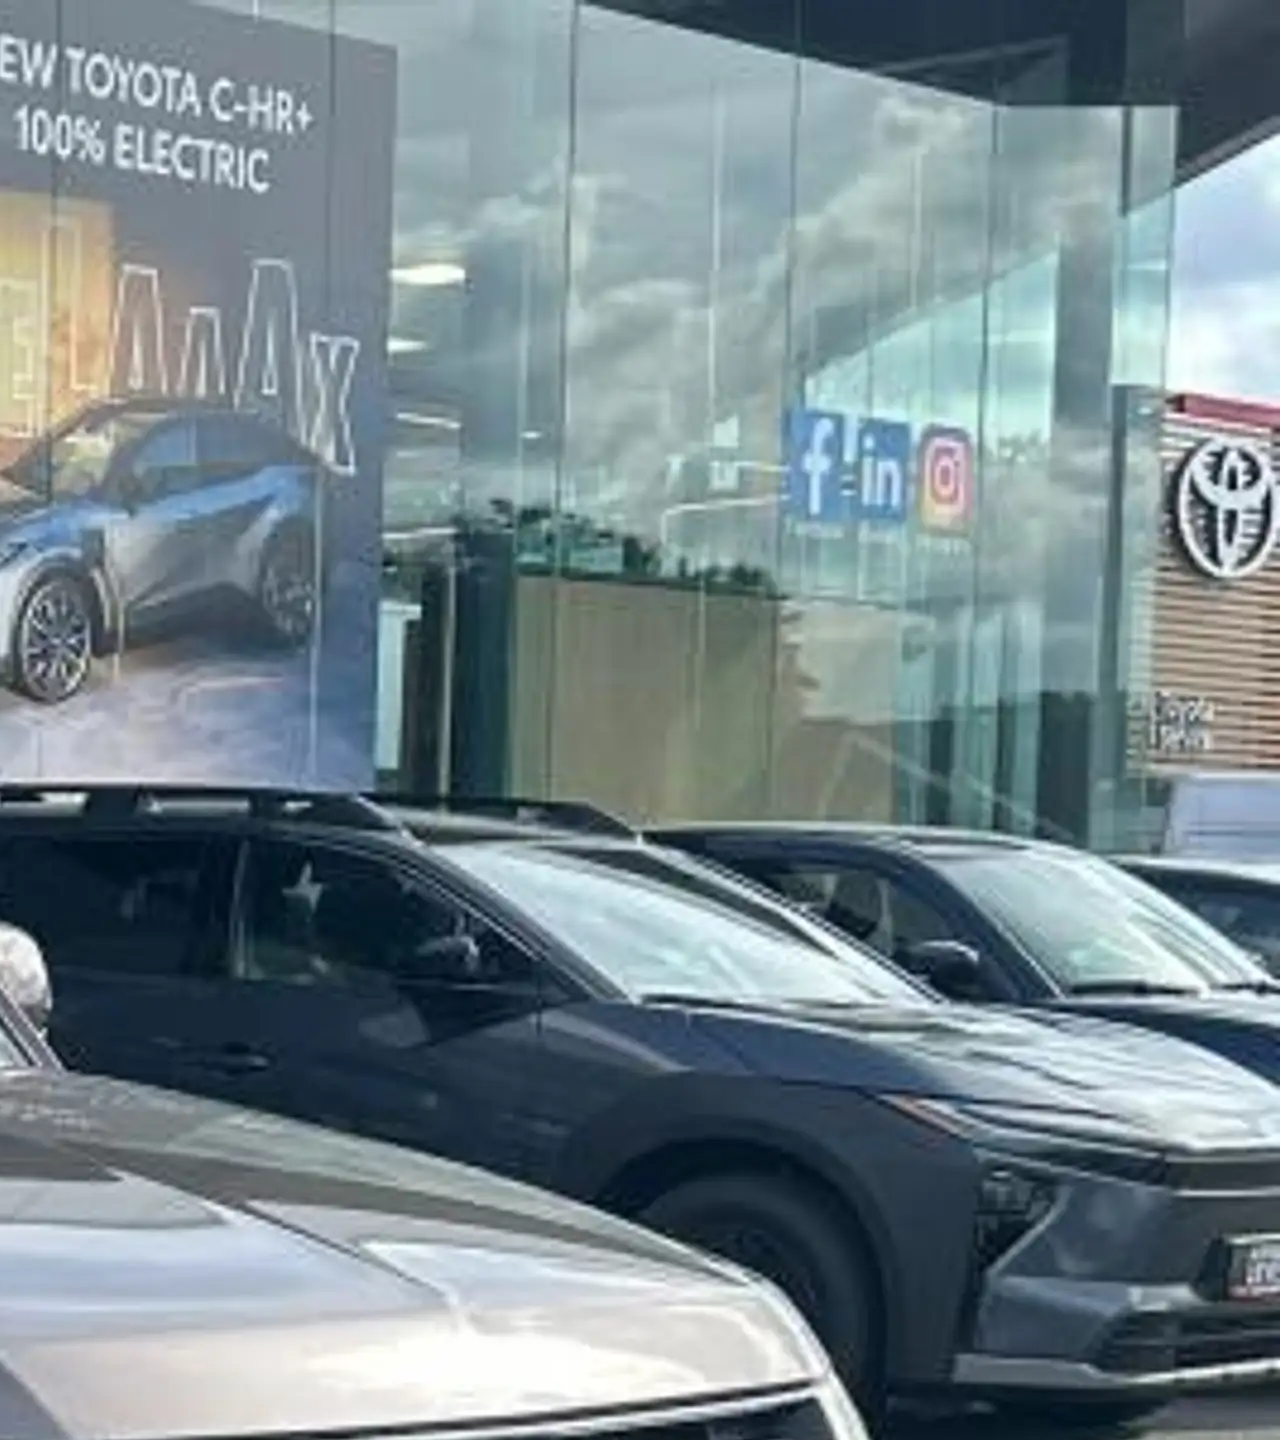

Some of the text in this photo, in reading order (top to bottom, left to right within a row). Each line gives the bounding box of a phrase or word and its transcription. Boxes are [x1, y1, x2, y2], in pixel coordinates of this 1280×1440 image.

[65, 46, 203, 118] TOYOTA
[208, 76, 314, 135] C-HR+
[13, 104, 271, 195] 100% ELECTRIC
